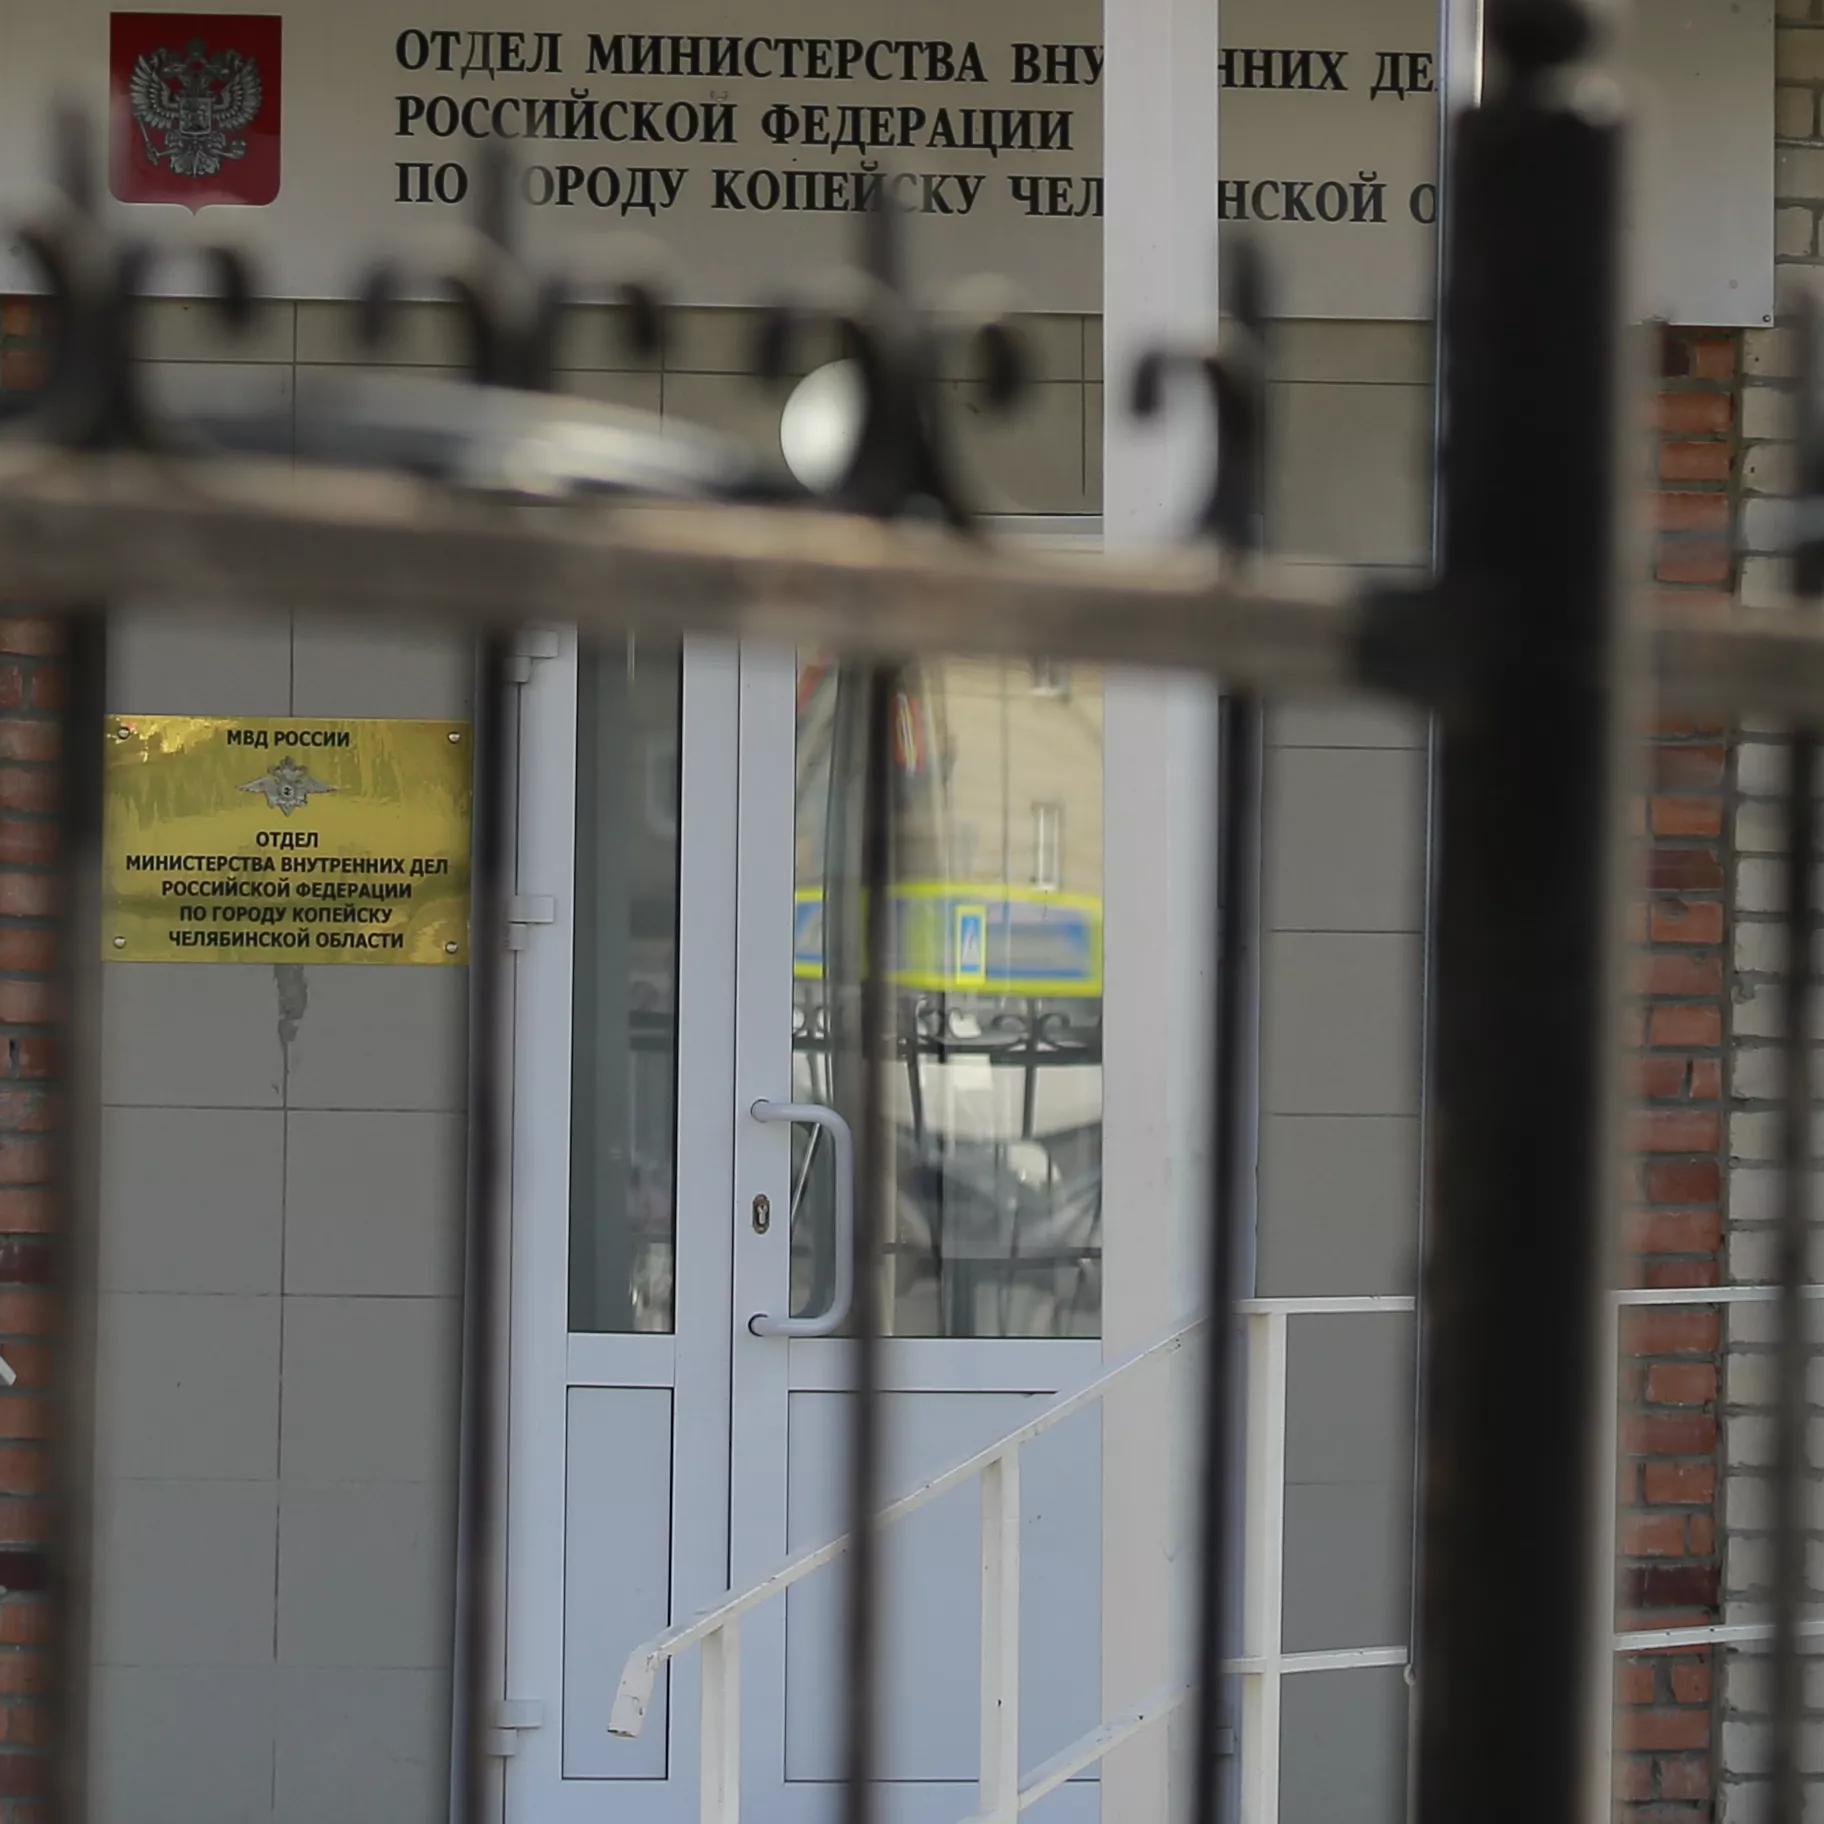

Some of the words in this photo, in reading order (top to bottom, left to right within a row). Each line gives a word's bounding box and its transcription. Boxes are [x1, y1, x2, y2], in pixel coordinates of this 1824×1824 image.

[395, 28, 563, 81] ОТДЕЛ
[585, 33, 988, 83] МИНИСТЕРСТВА
[1010, 42, 1348, 92] ВНУННИХ
[1371, 51, 1439, 101] ДЕ
[394, 87, 738, 144] РОССИЙСКОЙ
[761, 103, 1074, 158] ФЕДЕРАЦИИ
[394, 162, 468, 204] ПО
[506, 164, 689, 217] ОРОДУ
[1008, 170, 1388, 223] ЧЕЛНСКОЙ
[226, 730, 268, 748] МВД
[274, 731, 350, 748] РОССИИ
[256, 832, 318, 849] ОТДЕЛ
[126, 855, 275, 873] МИНИСТЕРСТВА
[281, 857, 404, 874] ВНУТРЕННИХ
[410, 859, 448, 876] ДЕЛ
[162, 877, 290, 898] РОССИЙСКОЙ
[295, 882, 412, 901] ФЕДЕРАЦИИ
[180, 905, 207, 921] ПО
[212, 906, 285, 925] ГОРОДУ
[293, 903, 392, 924] КОПЕЙСКУ
[169, 928, 309, 948] ЧЕЛЯБИНСКОЙ
[316, 932, 403, 949] ОБЛАСТИ
